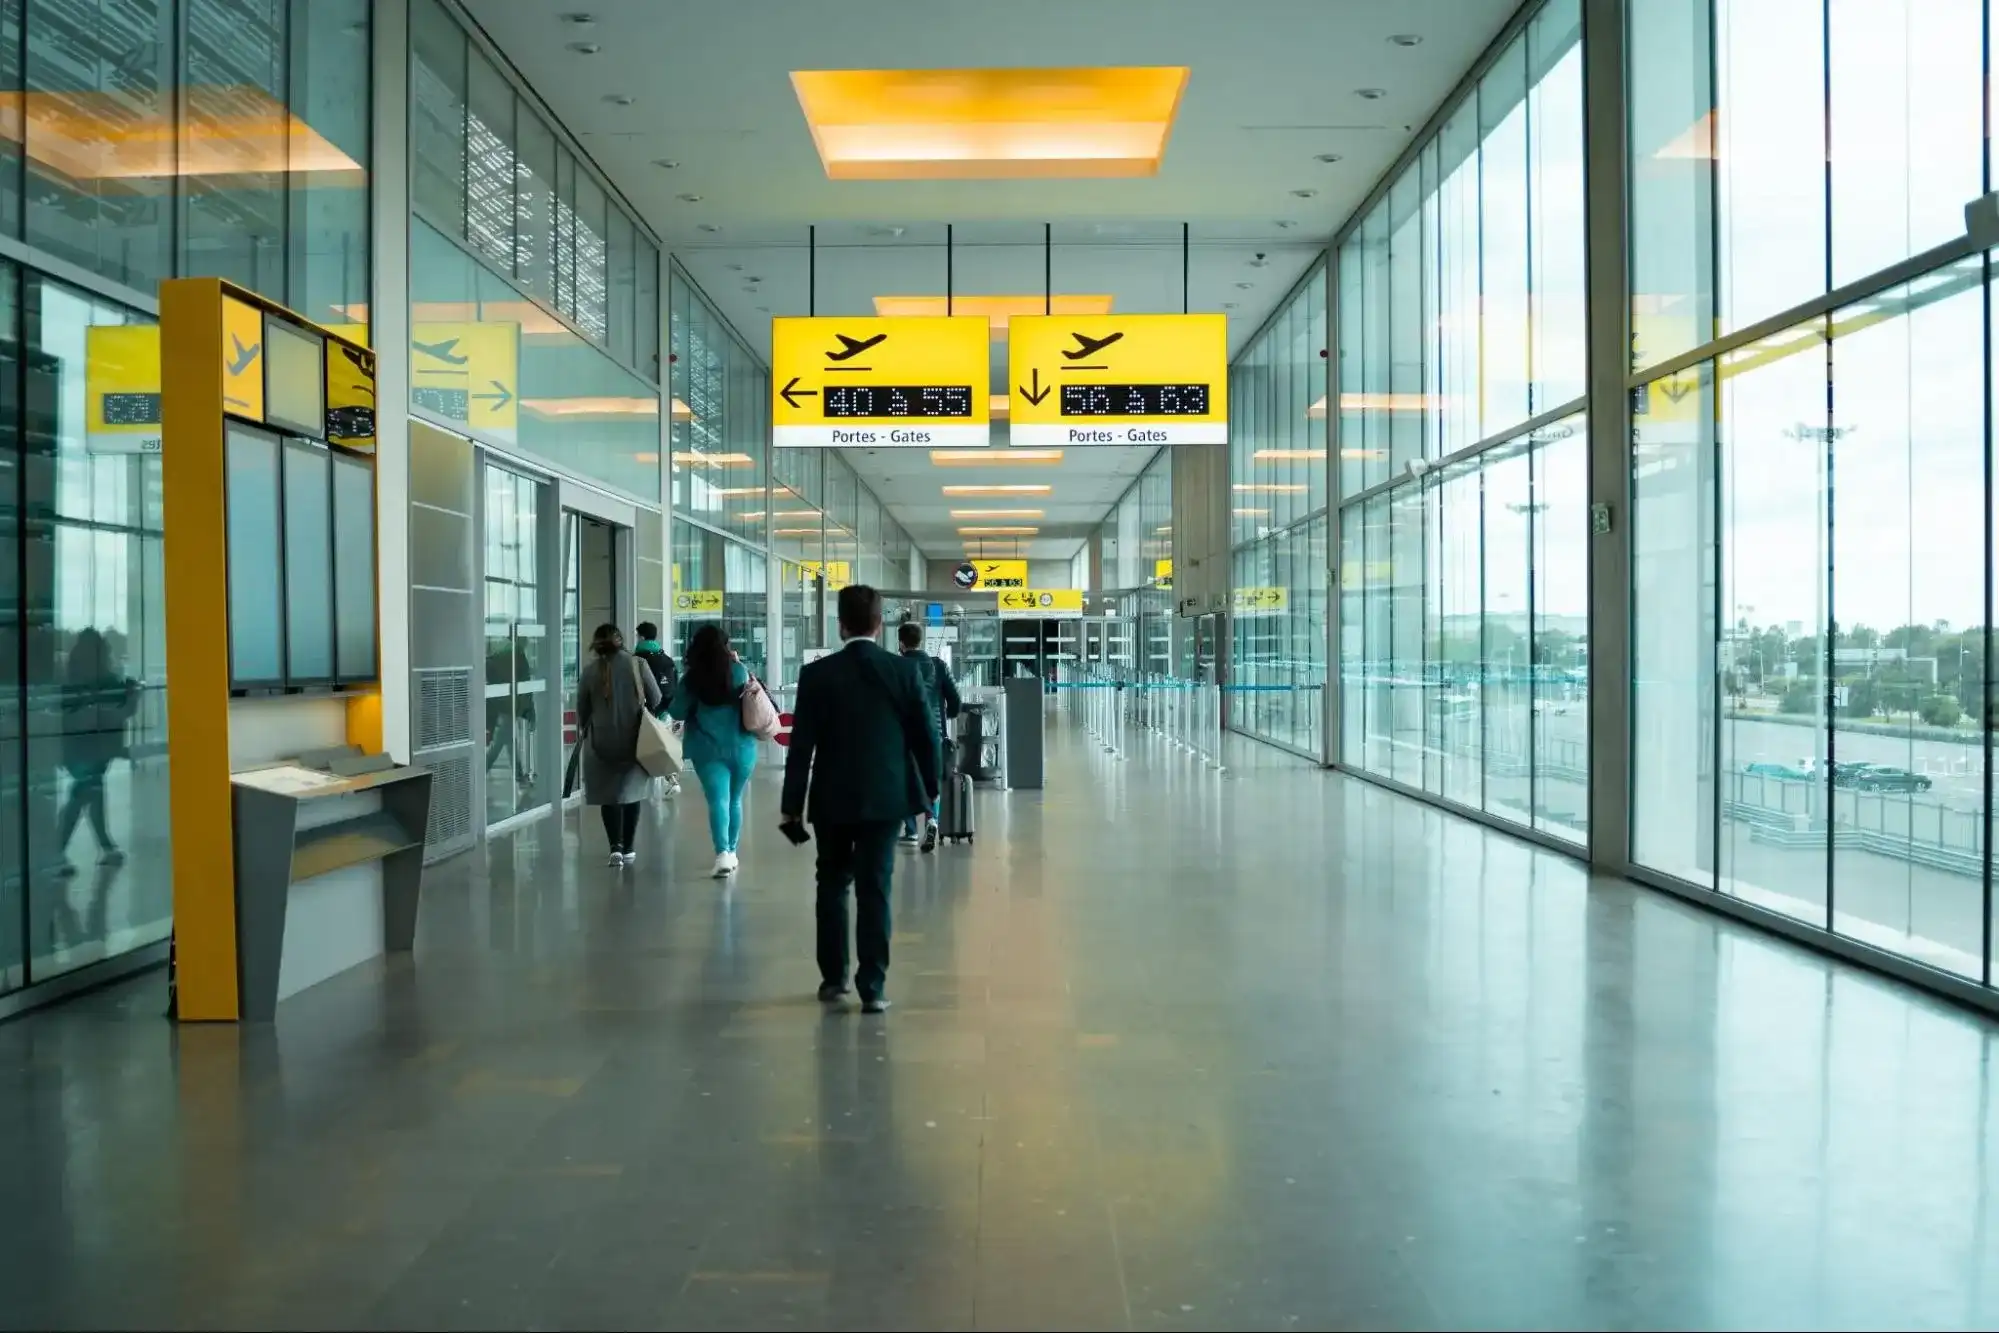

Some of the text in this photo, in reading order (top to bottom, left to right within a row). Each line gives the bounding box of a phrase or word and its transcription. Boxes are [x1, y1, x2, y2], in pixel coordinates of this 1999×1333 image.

[828, 387, 966, 415] 40 à 55
[1066, 386, 1203, 413] 56 à 63
[832, 430, 876, 442] Portes
[890, 429, 931, 442] Gates
[1069, 429, 1113, 442] Portes
[1127, 428, 1167, 441] Gates
